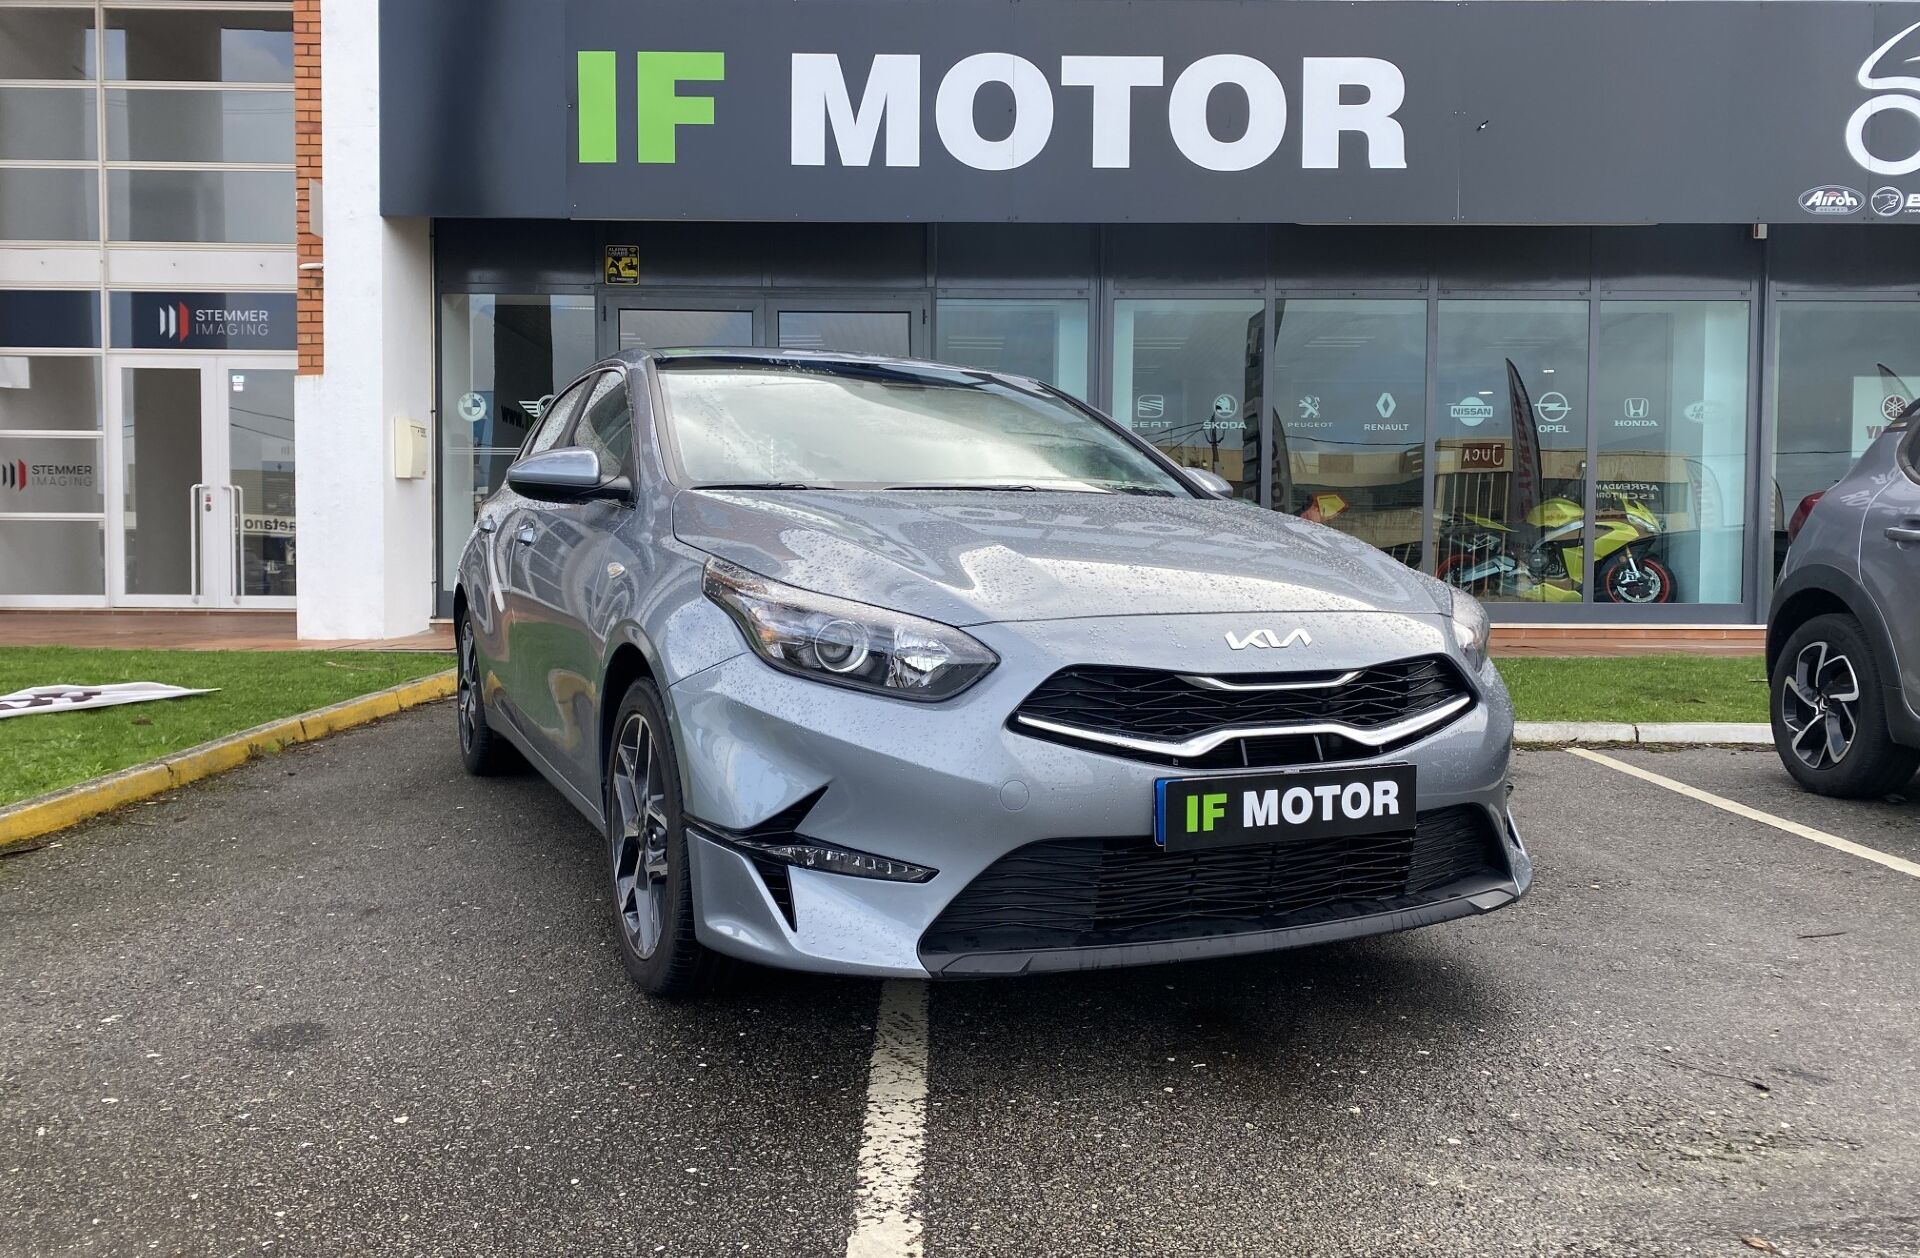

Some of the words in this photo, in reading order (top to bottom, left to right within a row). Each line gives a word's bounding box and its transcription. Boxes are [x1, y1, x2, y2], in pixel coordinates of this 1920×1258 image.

[577, 51, 725, 164] IF
[791, 52, 1407, 171] MOTOR
[1804, 190, 1858, 206] Airoh
[195, 309, 269, 322] STEMMER
[195, 323, 269, 336] IMAGING
[1452, 406, 1491, 416] NISSAN
[1363, 423, 1409, 431] RENAULT
[1538, 424, 1569, 433] OPEL
[1614, 419, 1658, 427] HONDA
[32, 464, 92, 475] STEMMER
[31, 476, 92, 487] IMAGING
[1186, 793, 1228, 833] IF
[1243, 780, 1399, 828] MOTOR
